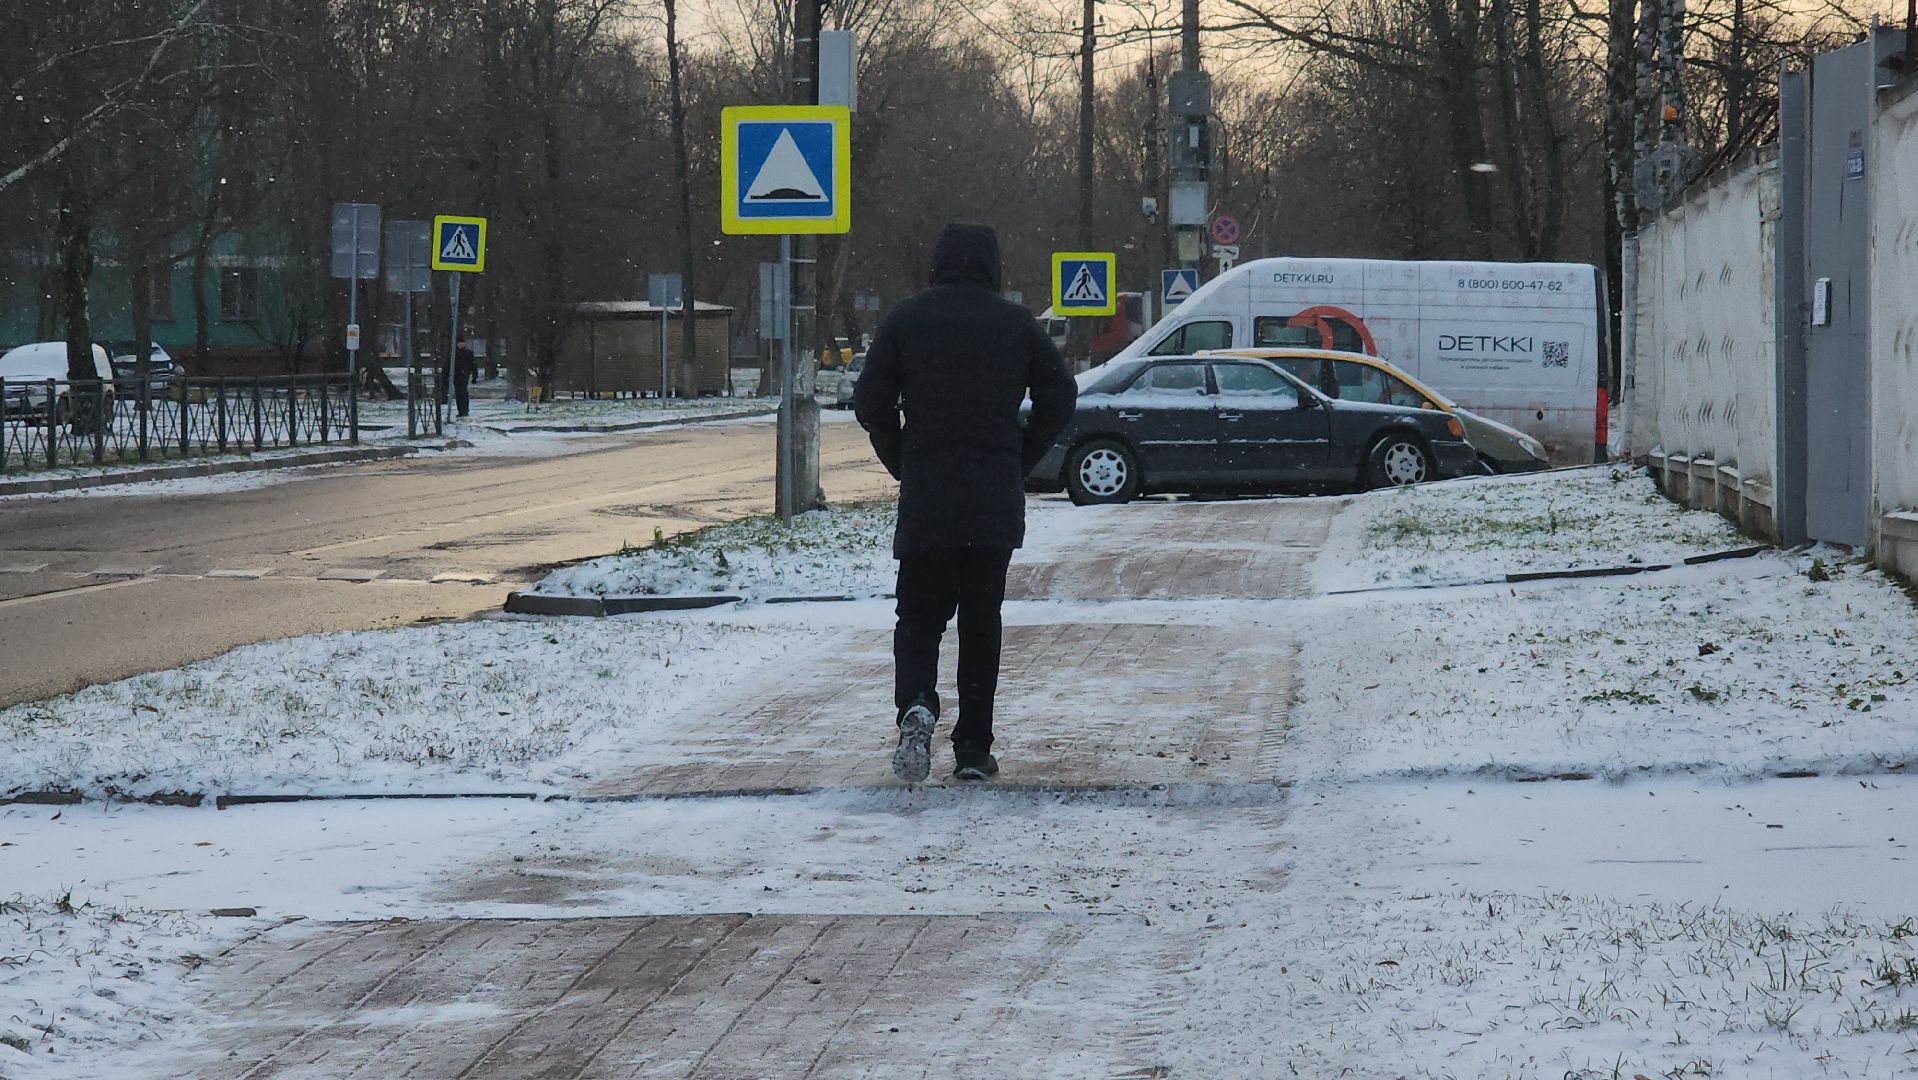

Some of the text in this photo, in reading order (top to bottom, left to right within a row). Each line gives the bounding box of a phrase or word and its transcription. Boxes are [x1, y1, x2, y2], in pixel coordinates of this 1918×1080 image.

[1273, 273, 1334, 284] DETKKI.RU
[1458, 278, 1563, 291] 8 (800) 600-47-62
[1438, 334, 1533, 353] DETKKI
